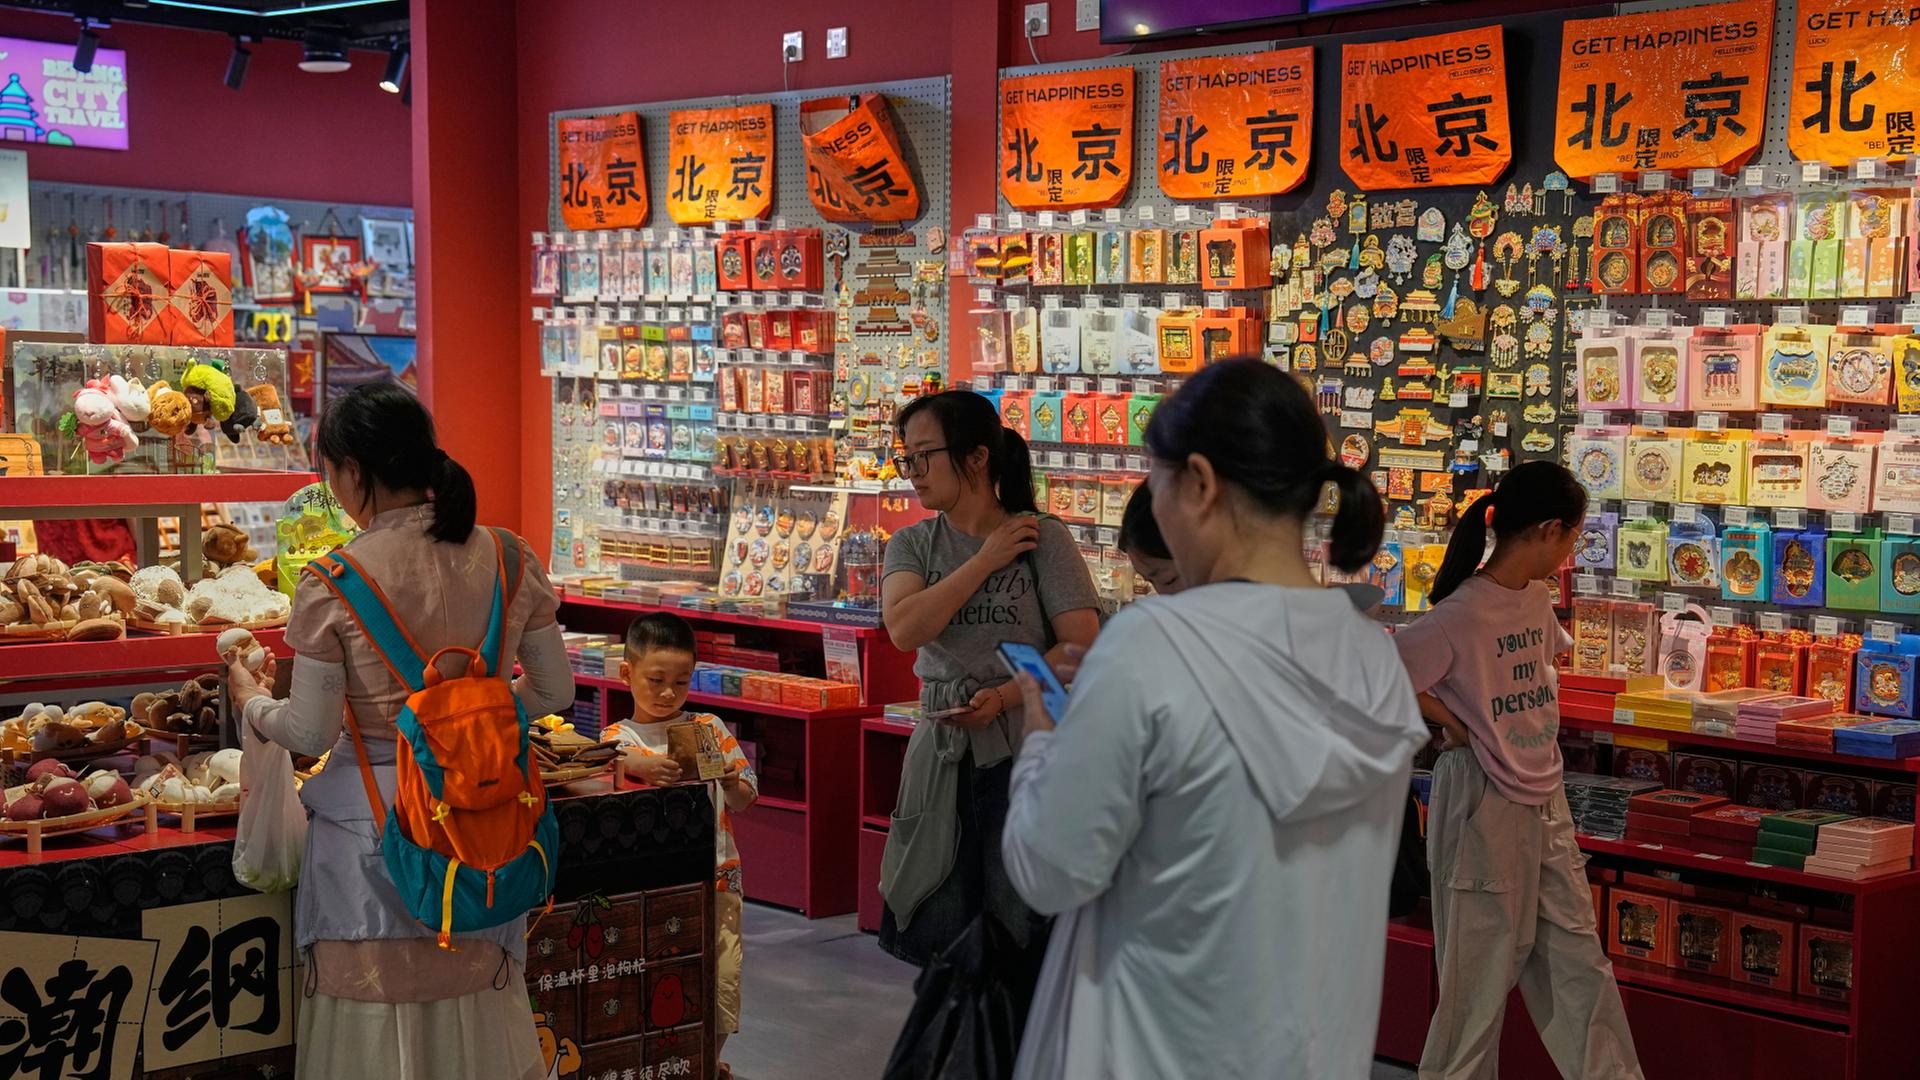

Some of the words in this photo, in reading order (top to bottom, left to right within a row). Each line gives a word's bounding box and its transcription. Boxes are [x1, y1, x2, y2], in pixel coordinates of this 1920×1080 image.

[1808, 11, 1860, 30] GET
[1572, 37, 1616, 56] GET
[1623, 21, 1758, 51] HAPPINESS
[1348, 60, 1366, 76] GET
[1370, 44, 1491, 75] HAPPINESS
[43, 79, 127, 111] CITY
[1006, 90, 1023, 104] GET
[1026, 83, 1124, 102] HAPPINESS
[1166, 75, 1193, 92] GET
[1198, 65, 1302, 89] HAPPINESS
[44, 105, 125, 129] TRAVEL
[1348, 92, 1499, 164] 北京
[1567, 72, 1749, 150] 北京
[561, 131, 582, 142] GET
[677, 122, 697, 135] GET
[1163, 109, 1298, 175] 北京
[1886, 111, 1915, 156] 限定
[1006, 123, 1121, 182] 北京
[1405, 148, 1432, 184] 限定
[1633, 128, 1660, 170] 限定
[562, 158, 641, 207] 北京
[672, 152, 766, 202] 北京
[1047, 169, 1063, 202] 限定
[1214, 159, 1234, 194] 限定
[704, 189, 719, 218] 限定
[1497, 627, 1544, 658] you're
[1513, 660, 1537, 682] my
[1491, 685, 1556, 722] person
[538, 958, 646, 992] 保温杯里泡枸杞
